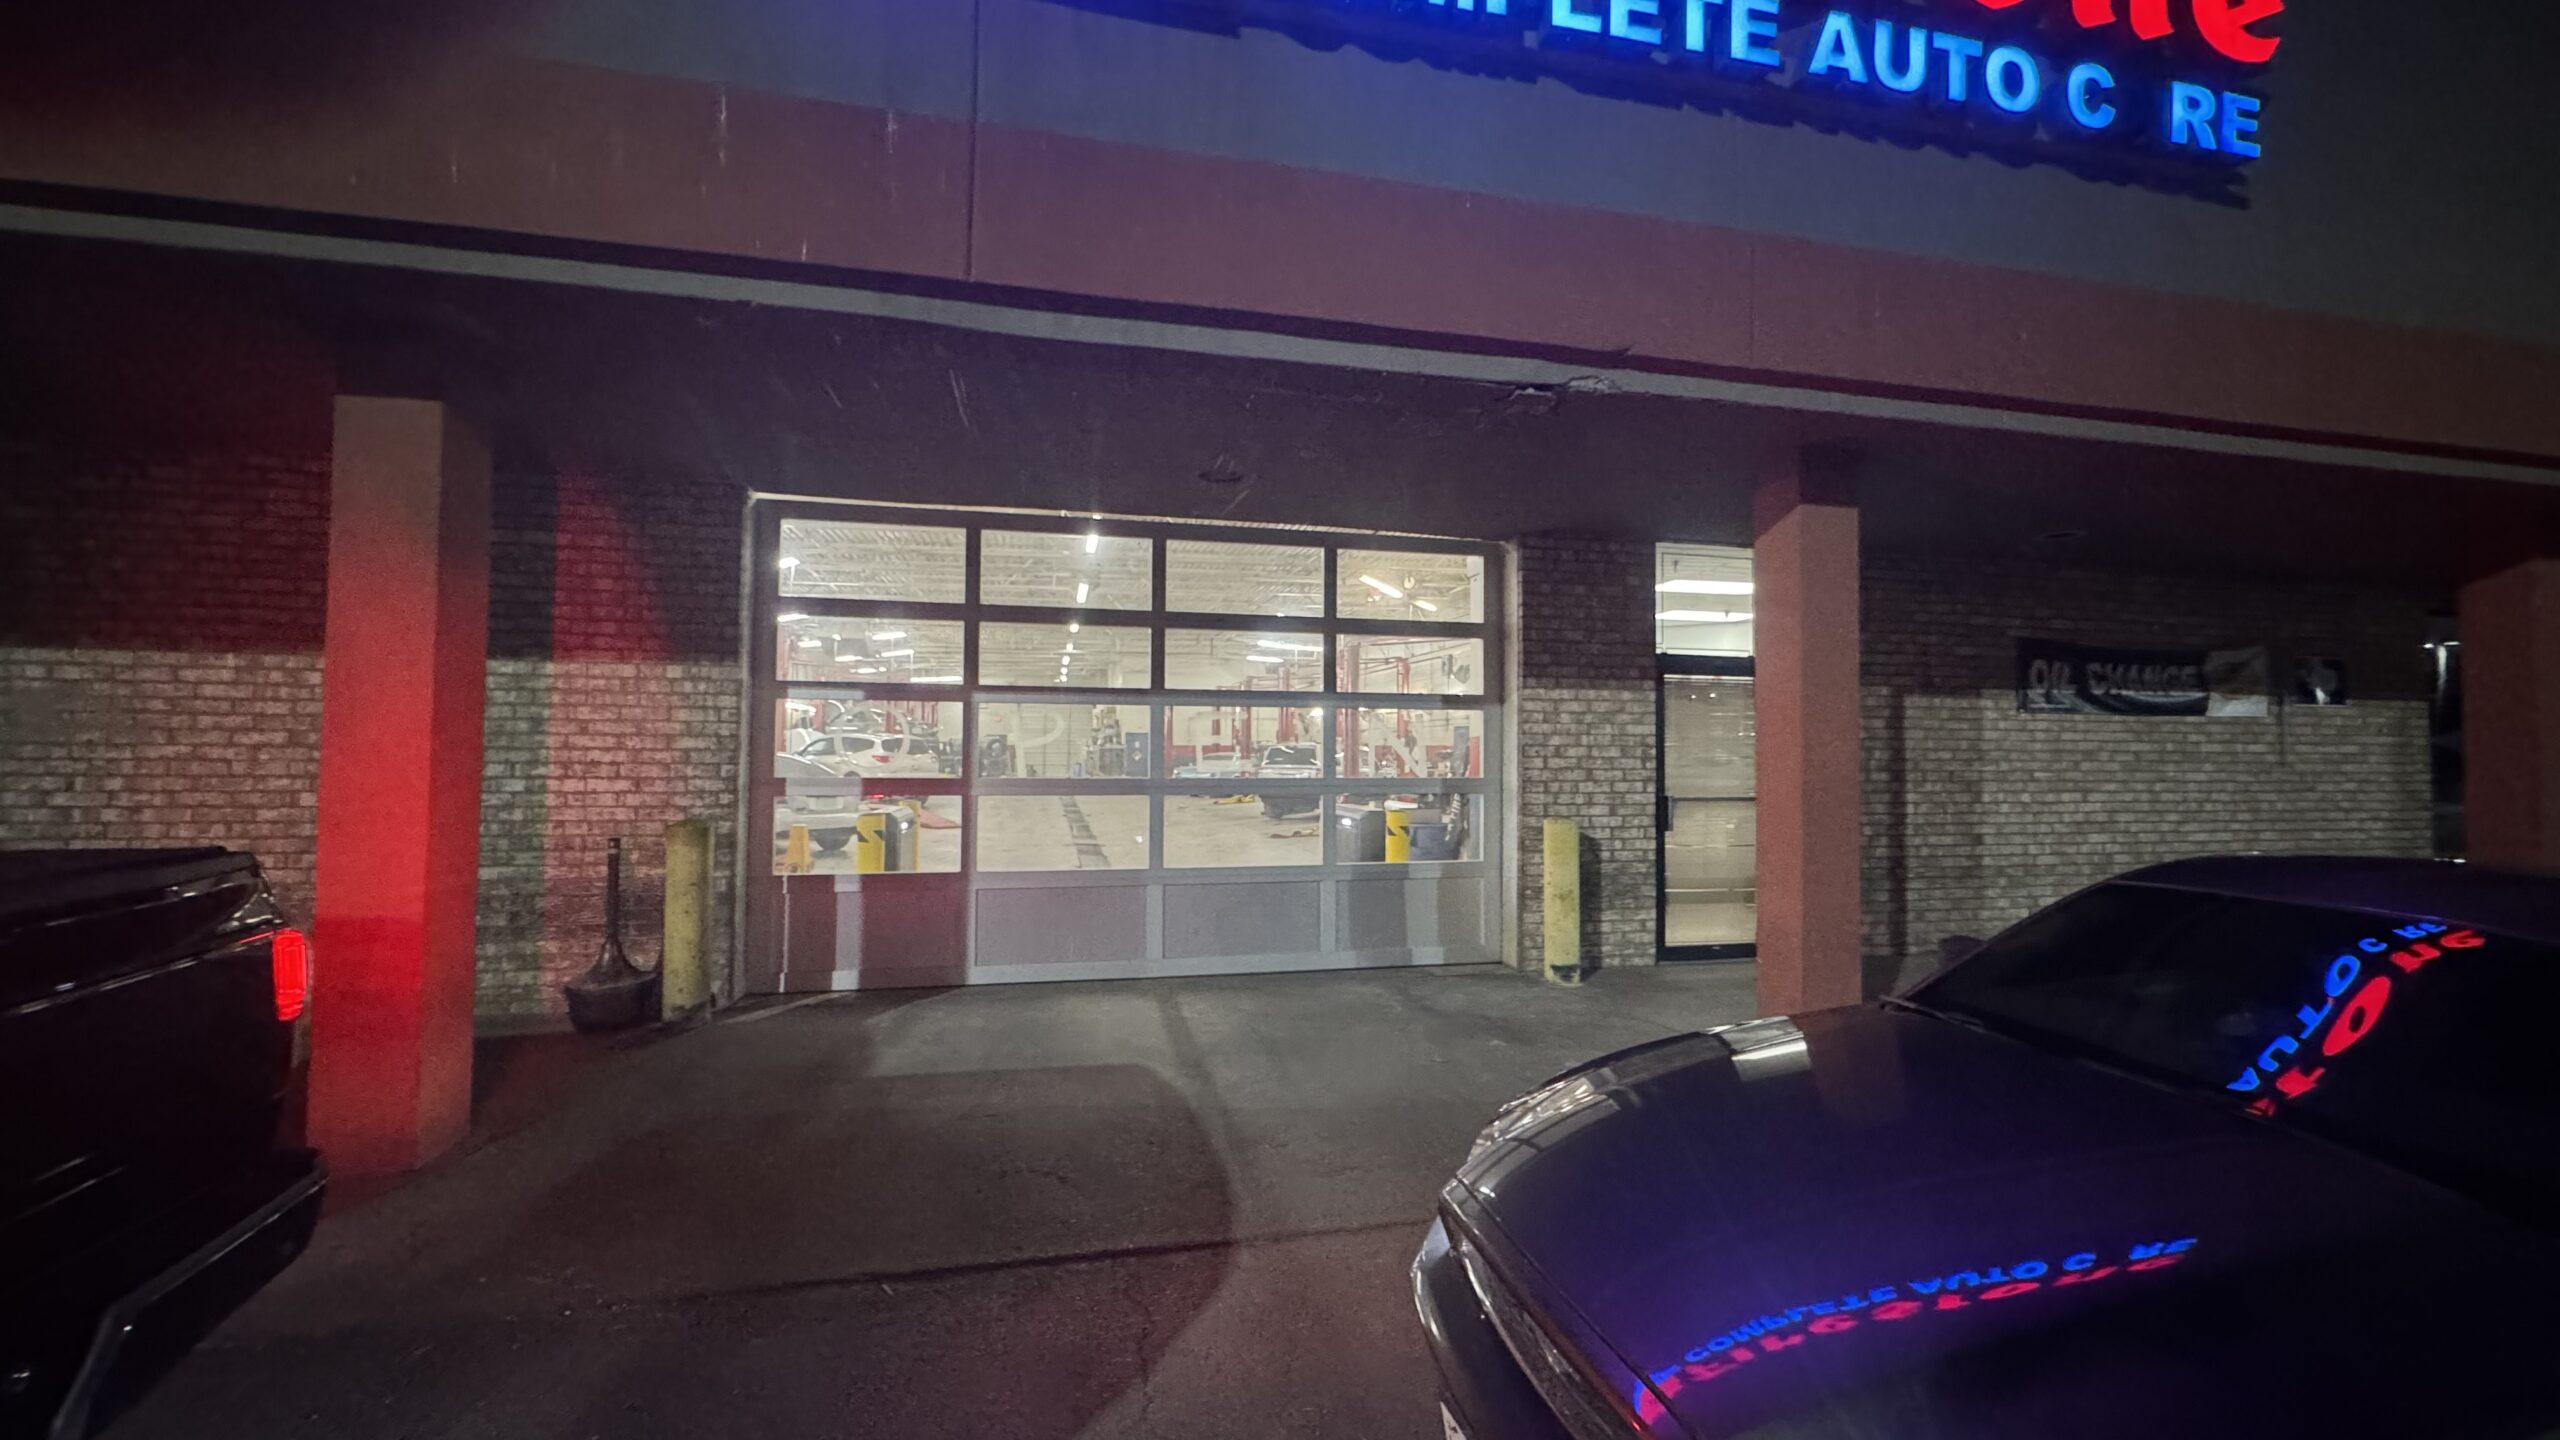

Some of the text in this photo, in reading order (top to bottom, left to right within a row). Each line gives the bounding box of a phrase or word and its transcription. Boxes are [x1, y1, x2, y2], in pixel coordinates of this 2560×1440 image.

[1807, 10, 2041, 114] AUTO
[2029, 658, 2200, 696] OIL CHANGE
